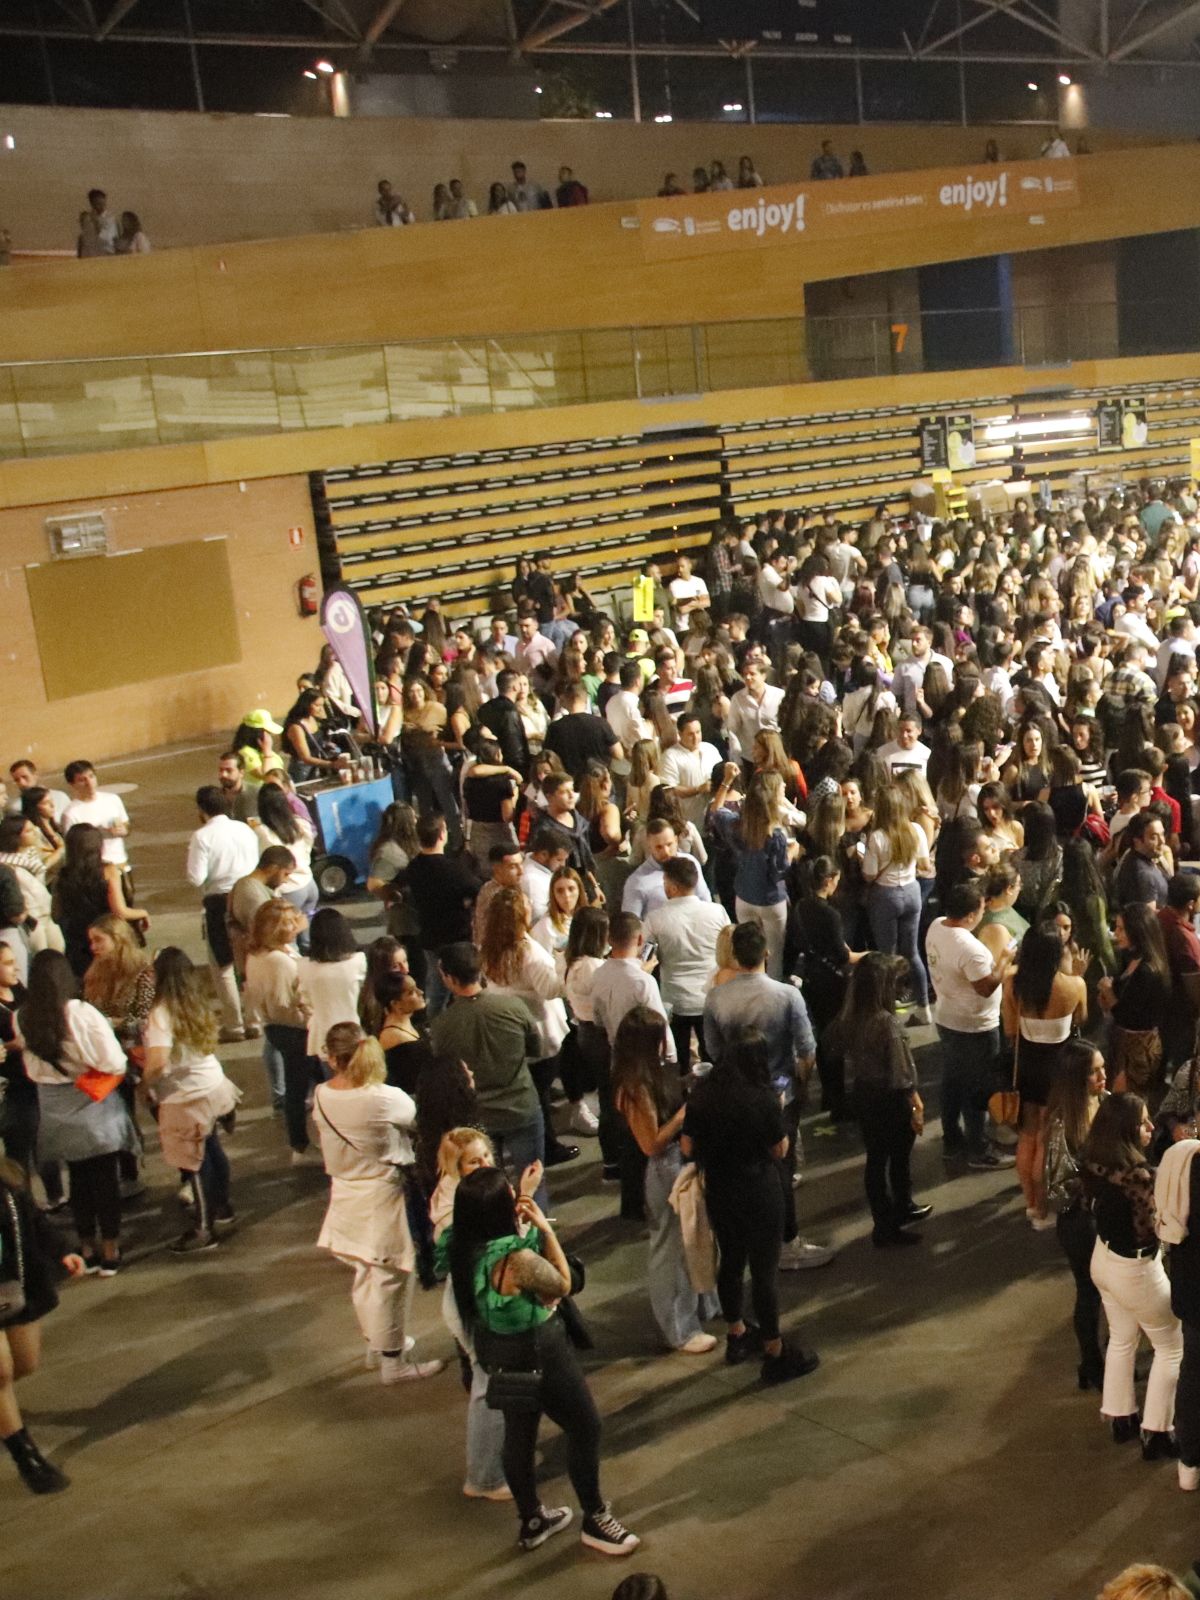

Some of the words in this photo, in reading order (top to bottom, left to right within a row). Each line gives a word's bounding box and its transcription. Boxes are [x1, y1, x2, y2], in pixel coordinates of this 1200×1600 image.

[940, 172, 1007, 210] enjoy!
[728, 193, 806, 236] enjoy!
[891, 323, 908, 352] 7
